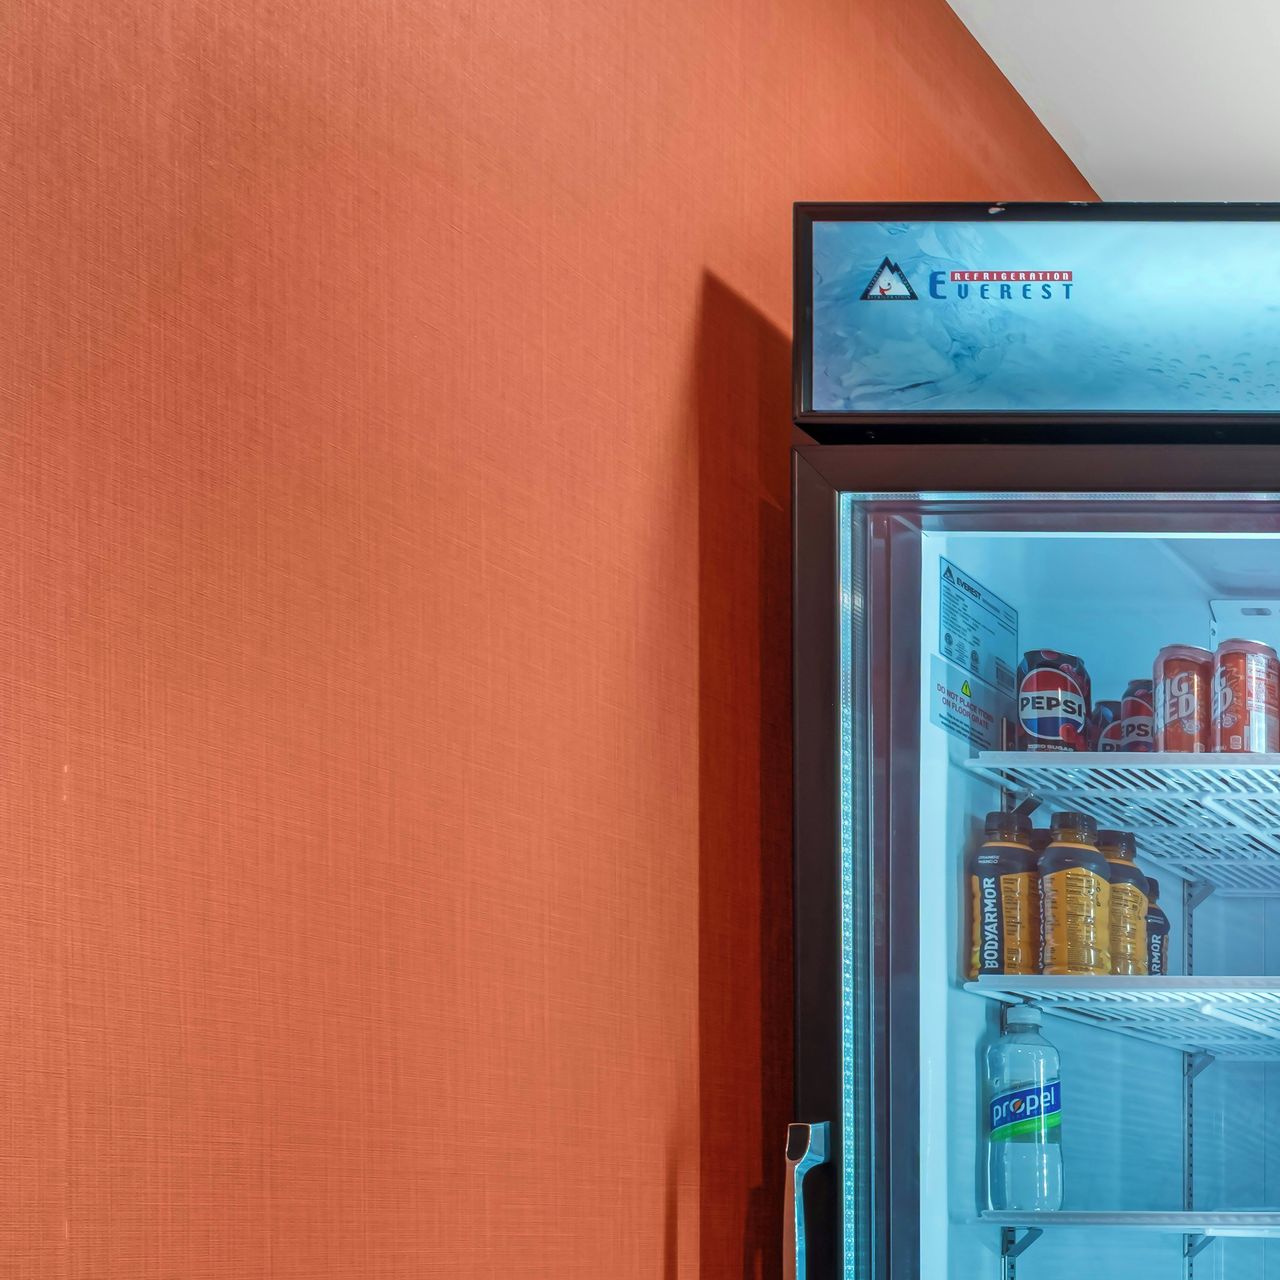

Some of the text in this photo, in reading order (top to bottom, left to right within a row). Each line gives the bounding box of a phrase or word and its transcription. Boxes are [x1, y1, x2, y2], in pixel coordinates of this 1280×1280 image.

[929, 270, 1074, 300] EVEREST
[953, 272, 1069, 281] REFRIGERATION
[956, 576, 982, 600] EVEREST
[937, 683, 946, 695] DO
[951, 703, 971, 719] FLOOR
[1020, 695, 1085, 718] PEPSI
[983, 876, 999, 970] BODYARMOR
[993, 1086, 1055, 1127] propel
